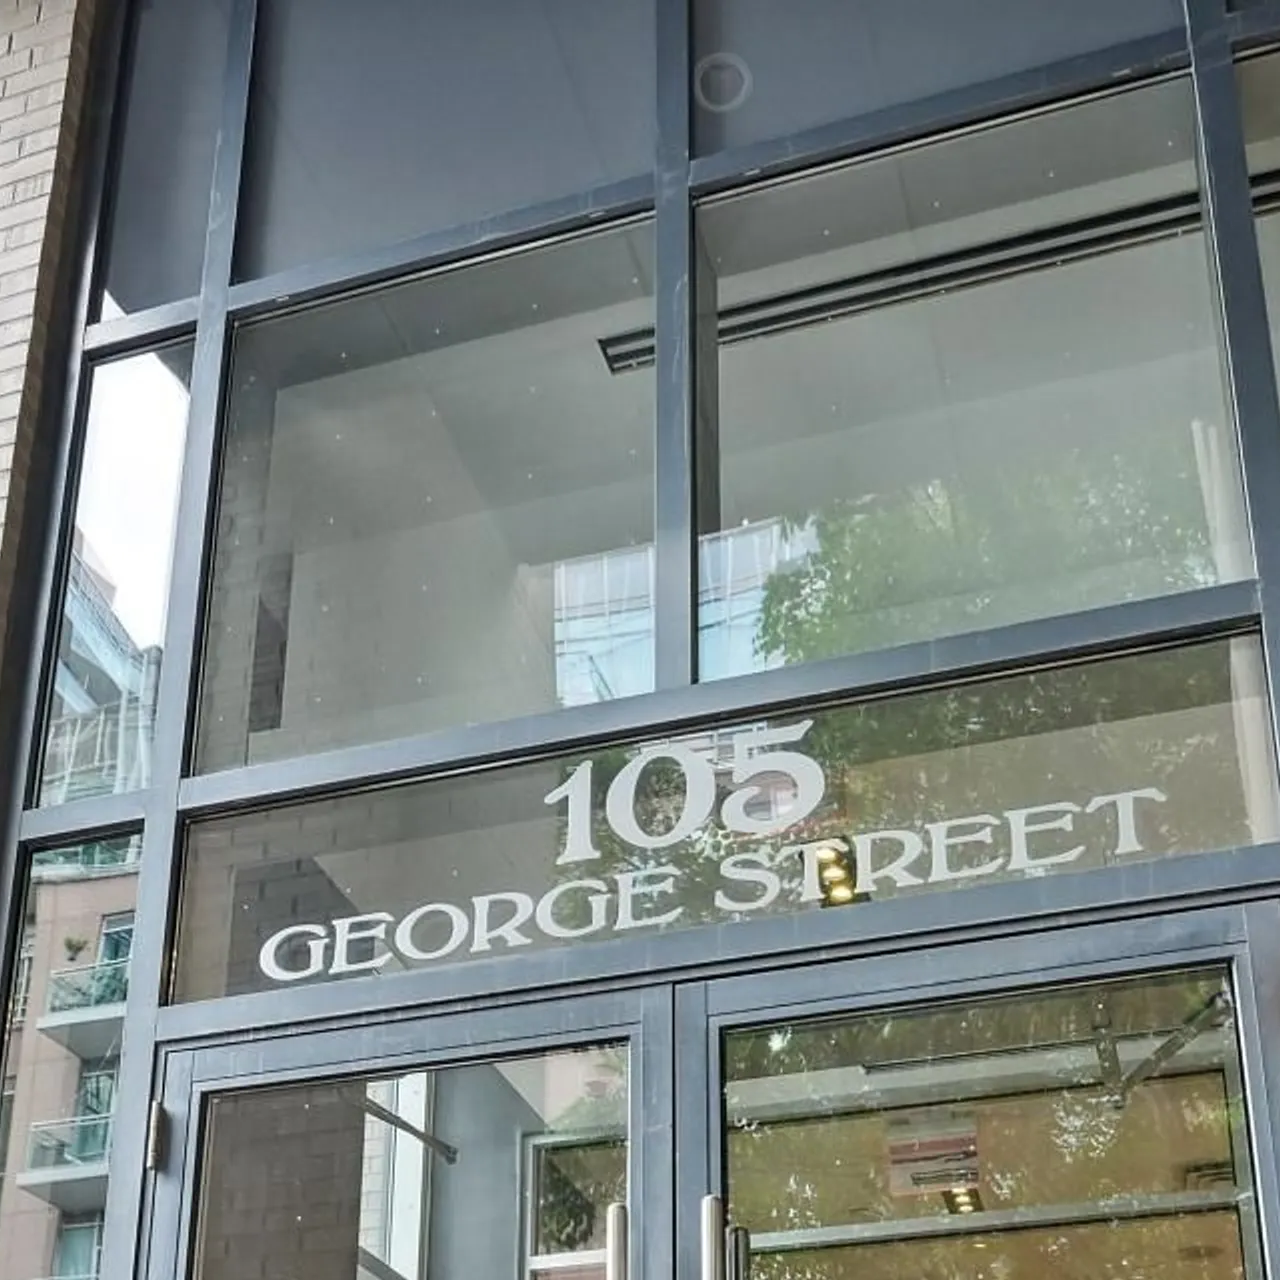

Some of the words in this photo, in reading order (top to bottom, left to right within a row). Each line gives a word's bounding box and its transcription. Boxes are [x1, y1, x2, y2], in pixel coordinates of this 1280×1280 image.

[543, 720, 827, 865] 105
[258, 866, 686, 982] GEORGE
[714, 787, 1168, 913] STREET
